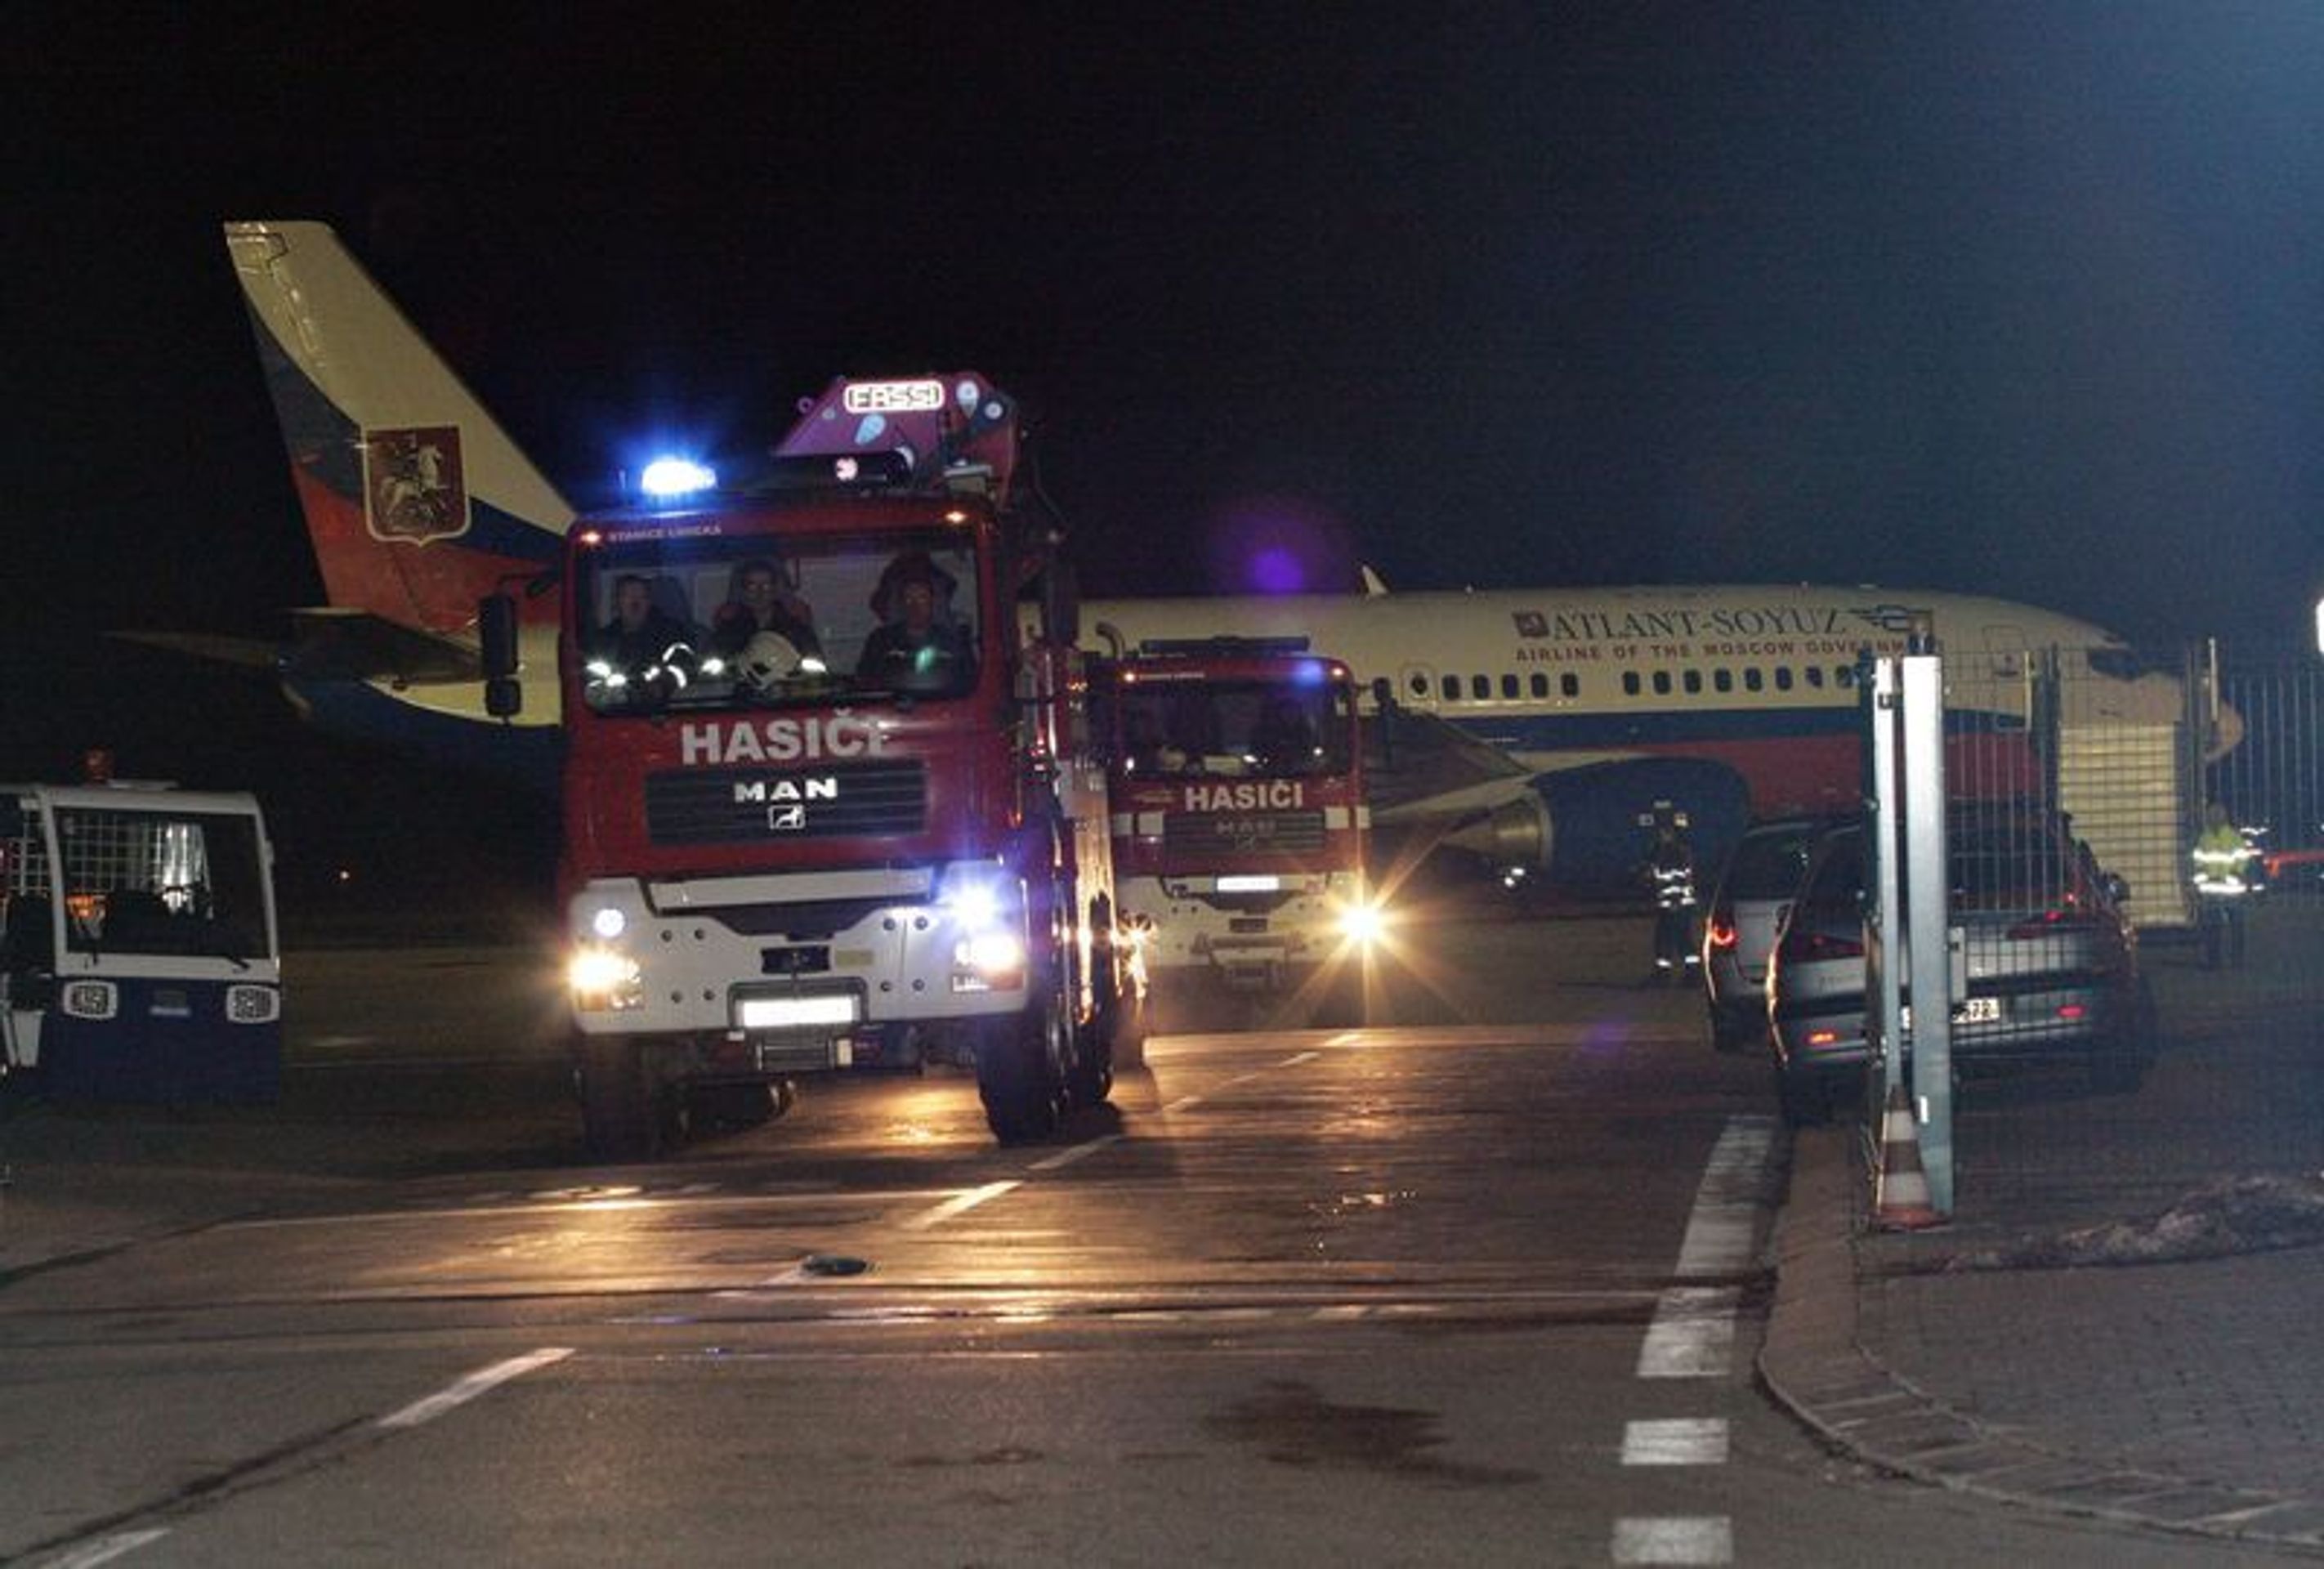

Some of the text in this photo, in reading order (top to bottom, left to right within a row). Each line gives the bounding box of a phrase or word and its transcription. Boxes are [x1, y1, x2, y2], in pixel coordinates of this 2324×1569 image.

[1553, 609, 1847, 641] ATLANT-SOYUZ
[1517, 646, 1600, 661] AIRLINE
[1613, 644, 1637, 659] OF
[1650, 643, 1690, 658] THE
[1701, 639, 1794, 655] MOSCOW
[682, 709, 883, 765] HASIČI
[734, 777, 838, 802] MAN
[1185, 780, 1303, 811] HASIČI
